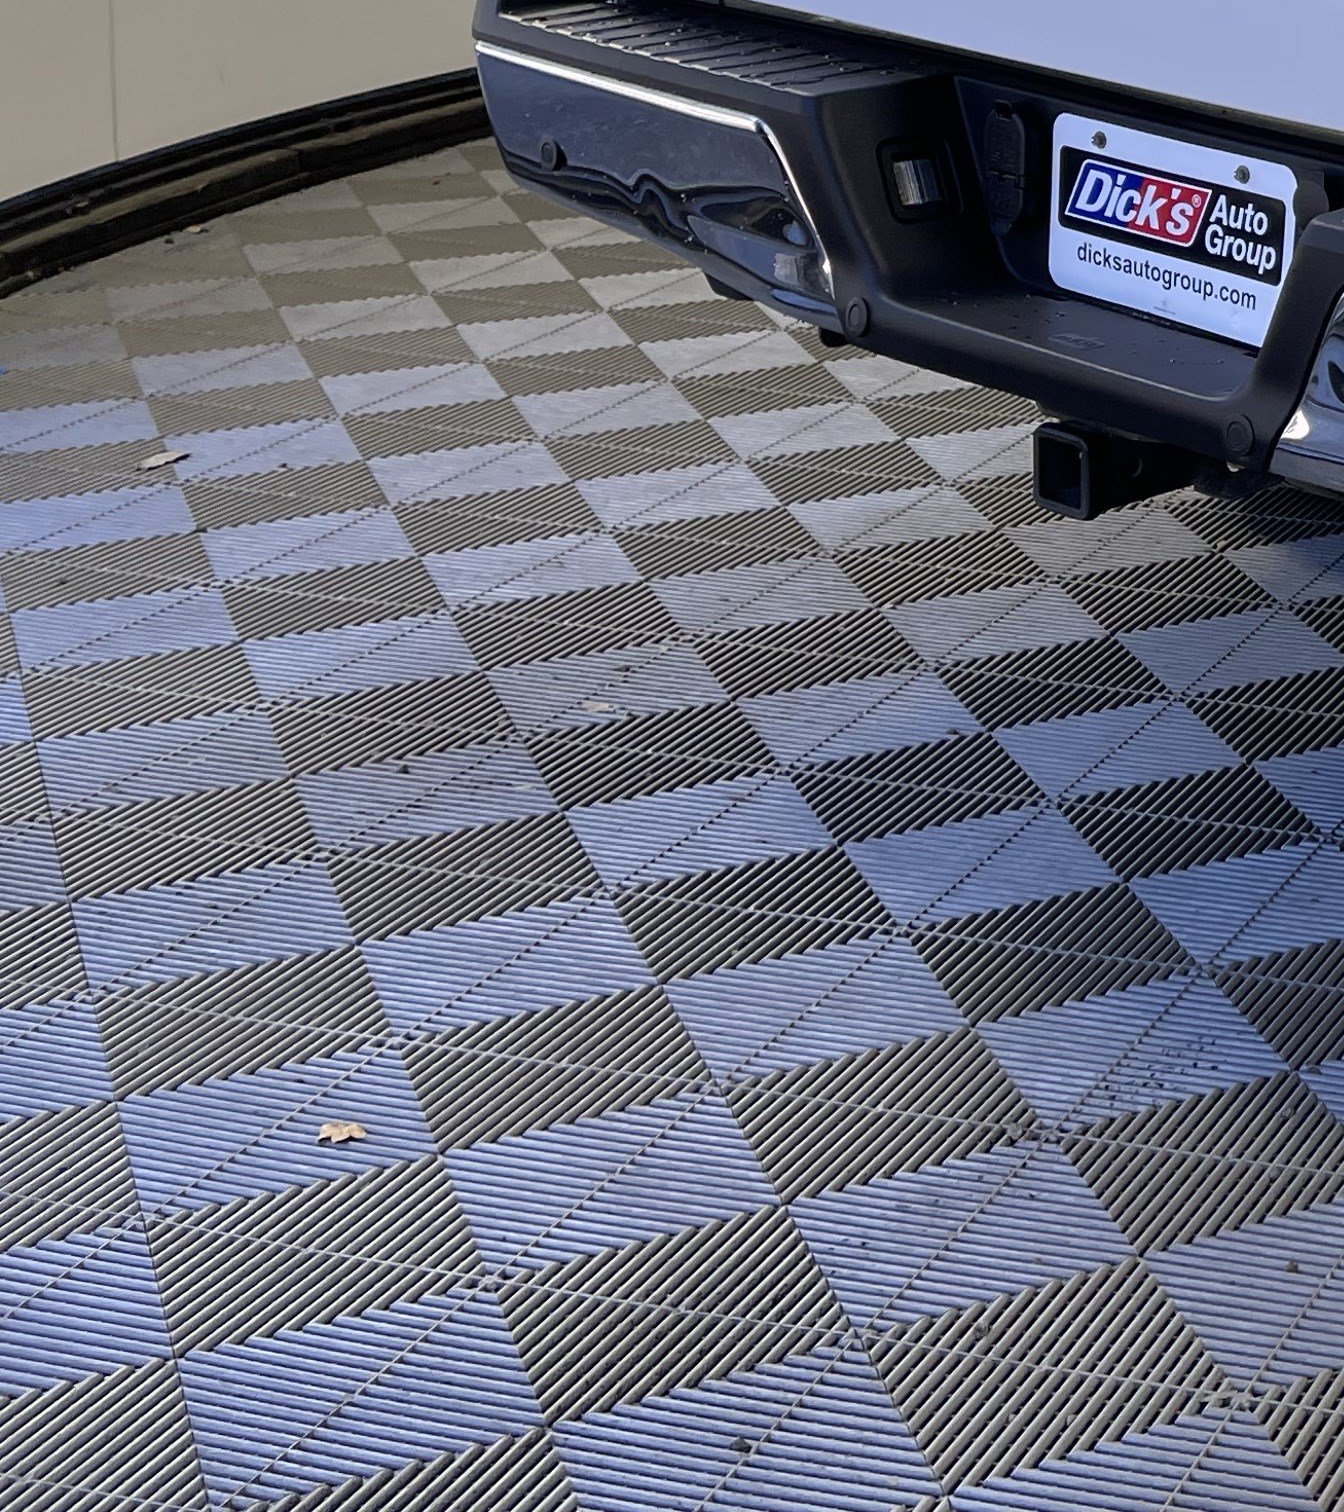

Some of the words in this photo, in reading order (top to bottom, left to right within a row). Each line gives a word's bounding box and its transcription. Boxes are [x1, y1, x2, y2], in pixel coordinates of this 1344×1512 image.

[1208, 194, 1269, 236] Auto
[1204, 223, 1277, 275] Group
[1076, 242, 1257, 311] dicksautogroup.com
